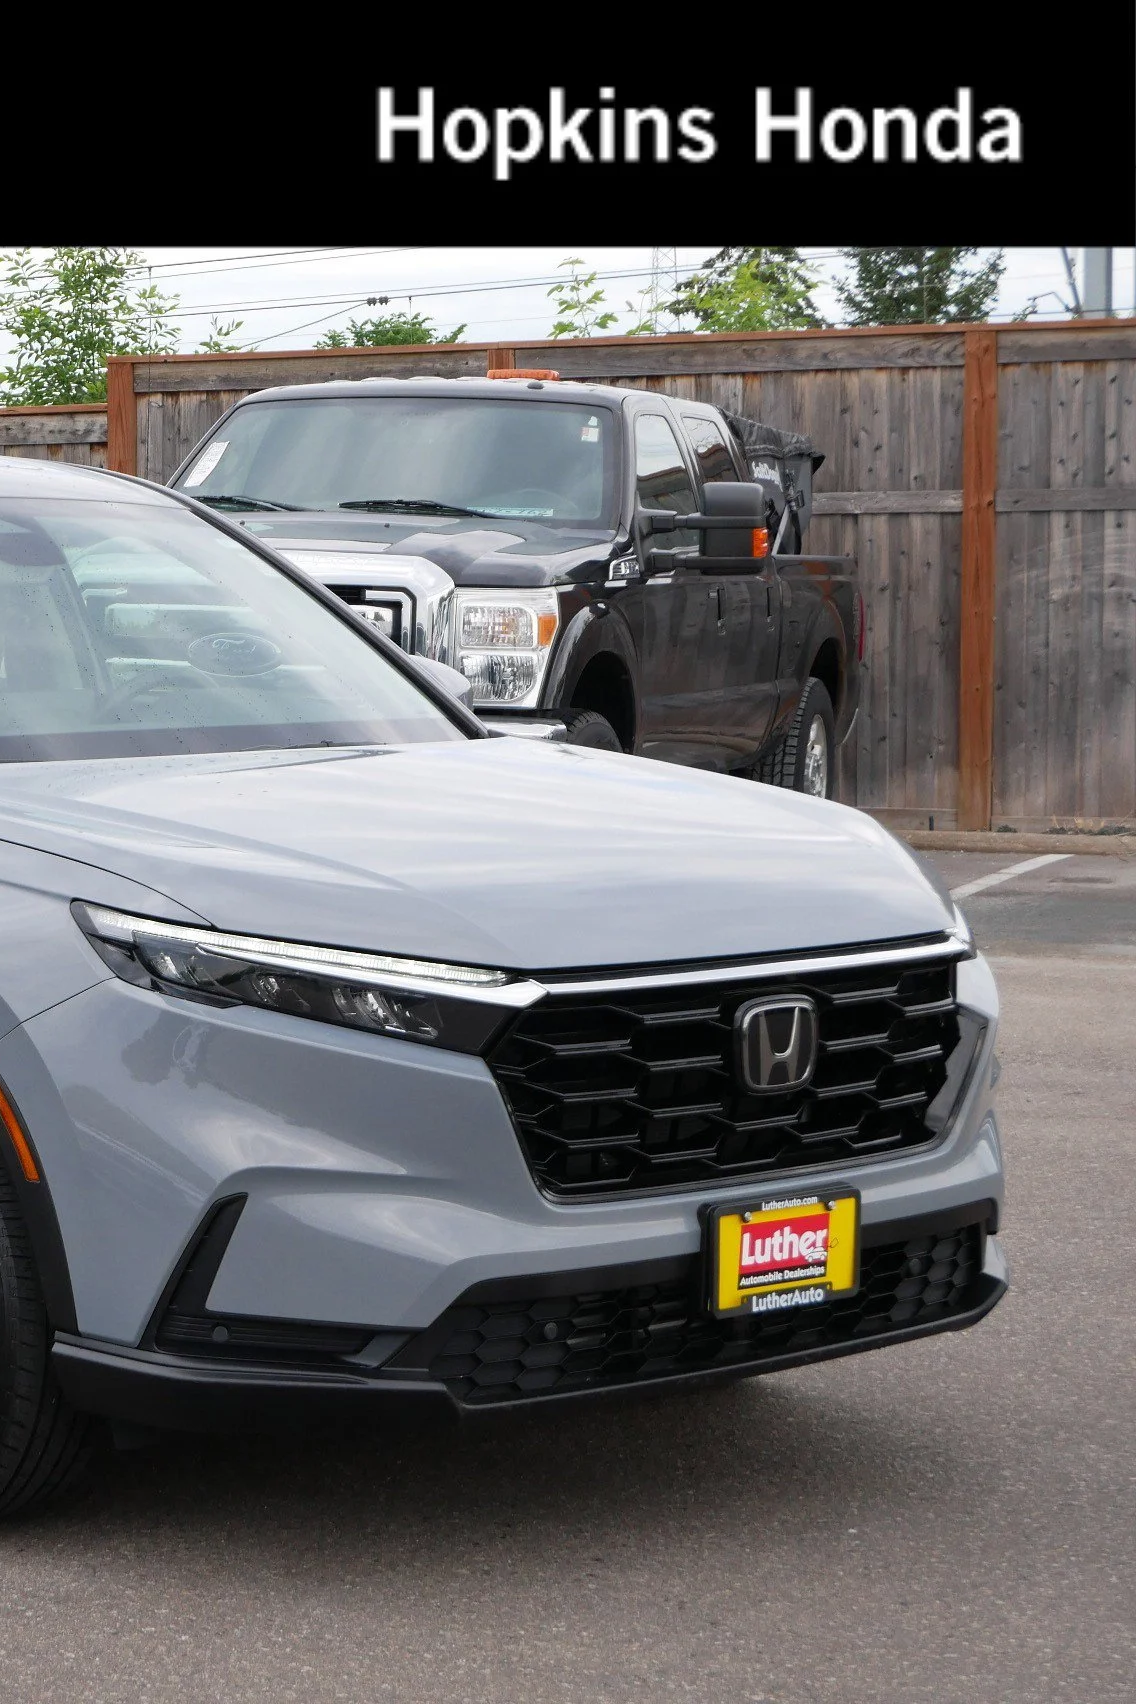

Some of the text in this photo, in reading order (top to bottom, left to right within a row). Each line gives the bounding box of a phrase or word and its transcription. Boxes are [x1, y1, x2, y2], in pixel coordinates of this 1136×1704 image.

[761, 1195, 818, 1212] LutherAuto.com
[741, 1225, 829, 1266] Luther
[739, 1265, 826, 1287] Automobile Dealerships
[752, 1286, 825, 1313] LutherAuto
